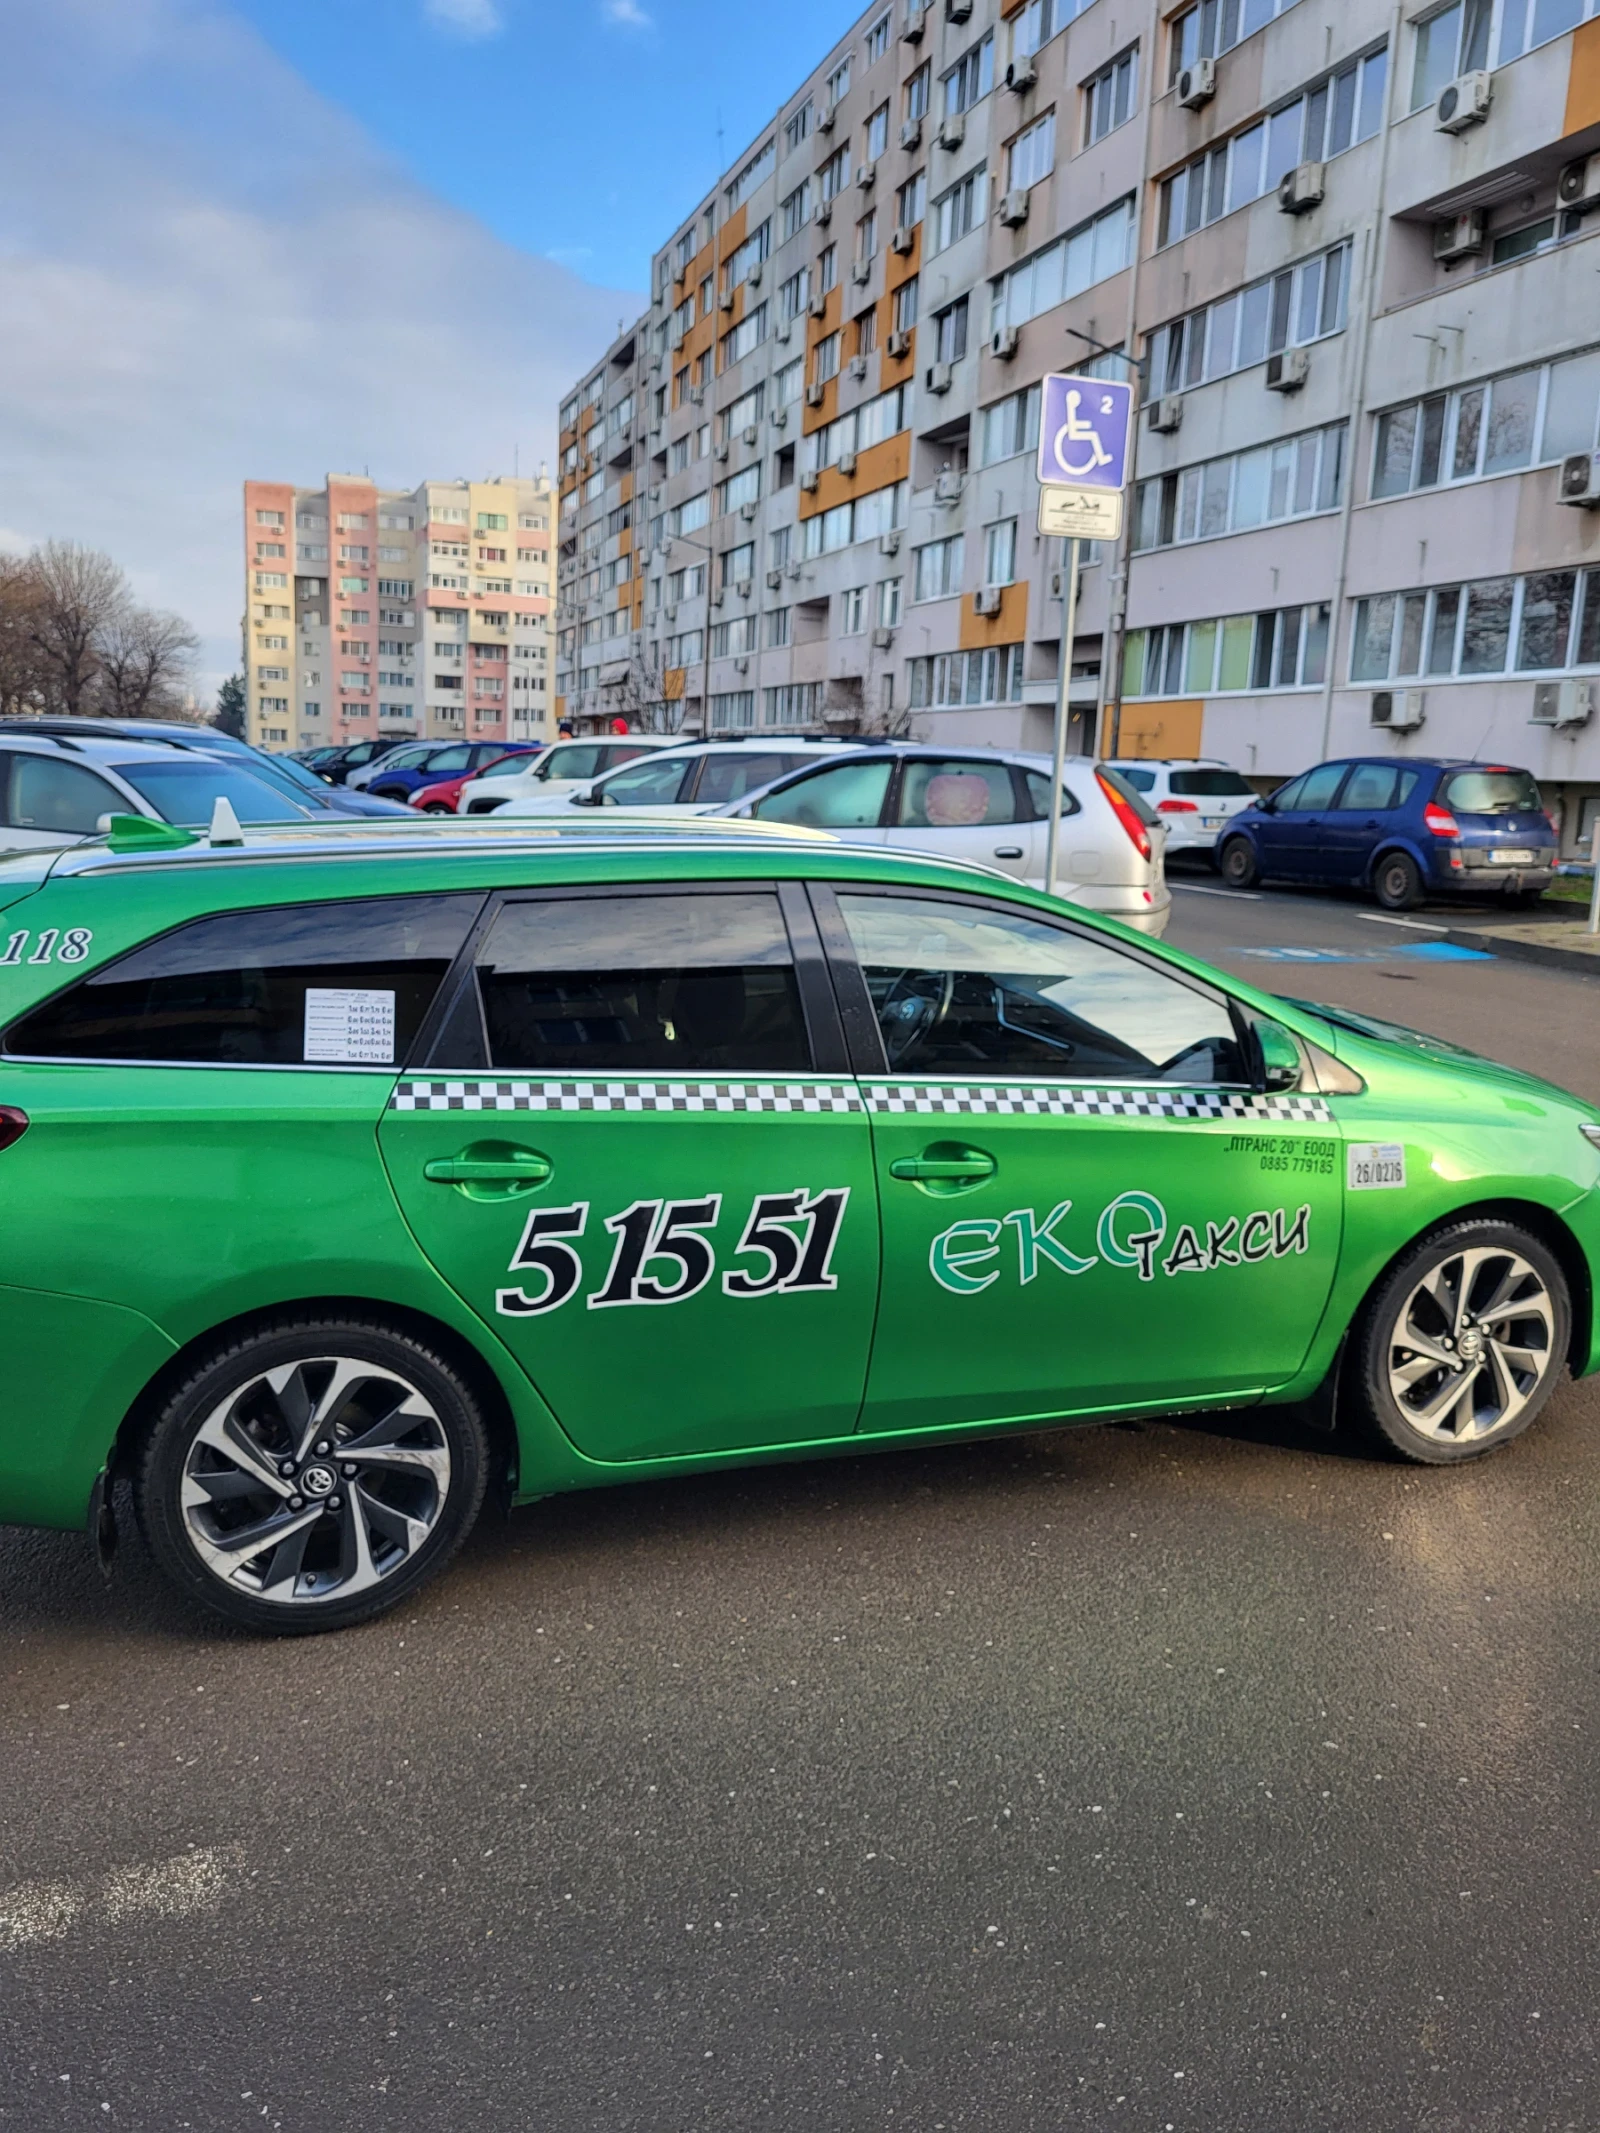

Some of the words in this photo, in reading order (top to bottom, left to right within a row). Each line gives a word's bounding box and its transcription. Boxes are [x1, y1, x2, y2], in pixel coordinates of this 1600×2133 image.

[1100, 395, 1114, 415] 2
[0, 928, 93, 966] 118
[1130, 1203, 1310, 1281] ТАКСИ
